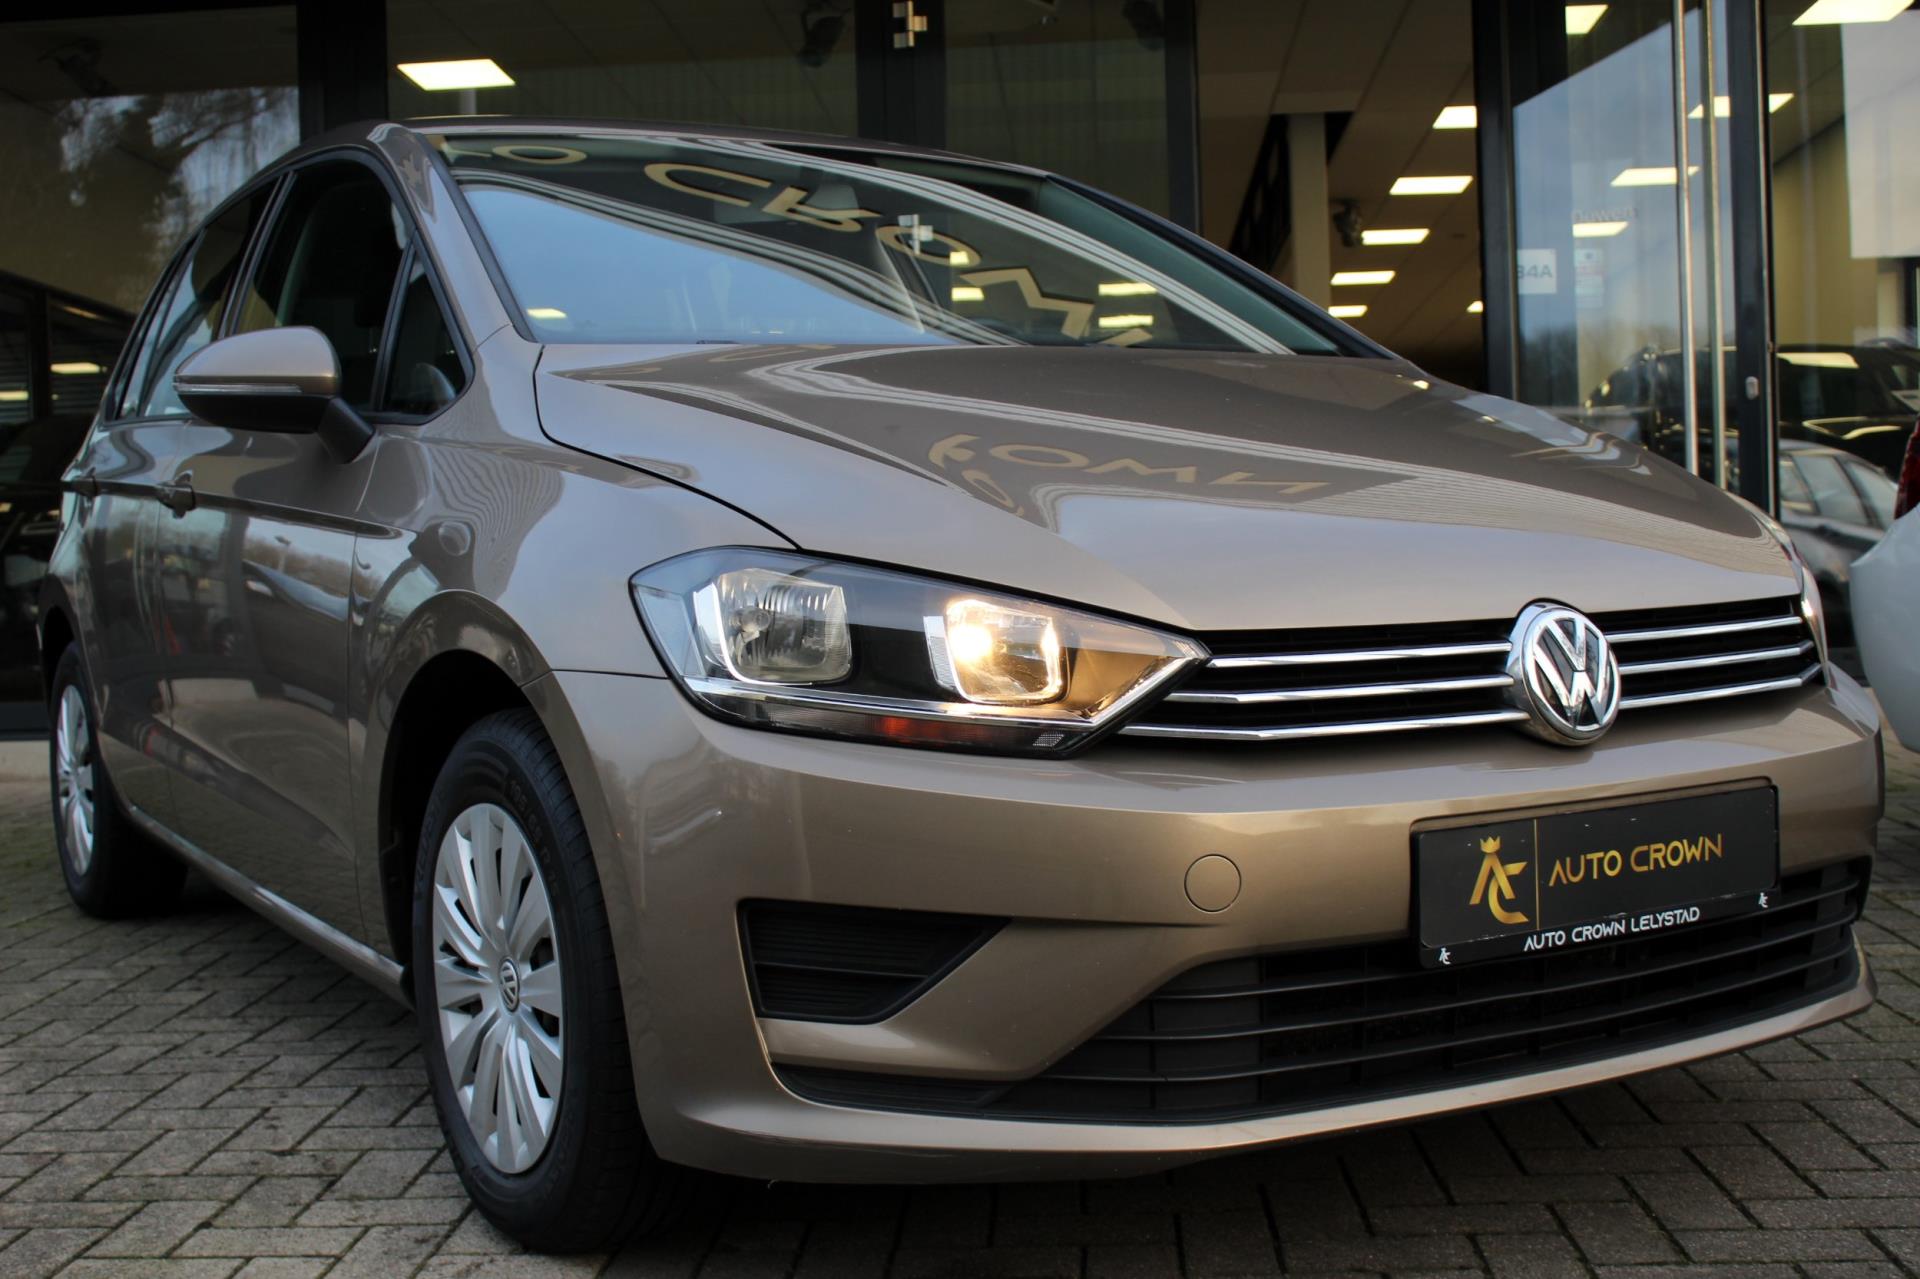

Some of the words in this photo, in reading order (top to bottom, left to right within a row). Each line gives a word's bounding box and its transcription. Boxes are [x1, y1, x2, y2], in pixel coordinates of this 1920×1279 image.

[1549, 850, 1622, 887] AUTO
[1630, 833, 1722, 873] CROWN
[1524, 931, 1566, 952] AUTO
[1572, 920, 1626, 943] CROWN
[1631, 906, 1701, 932] LELYSTAD
